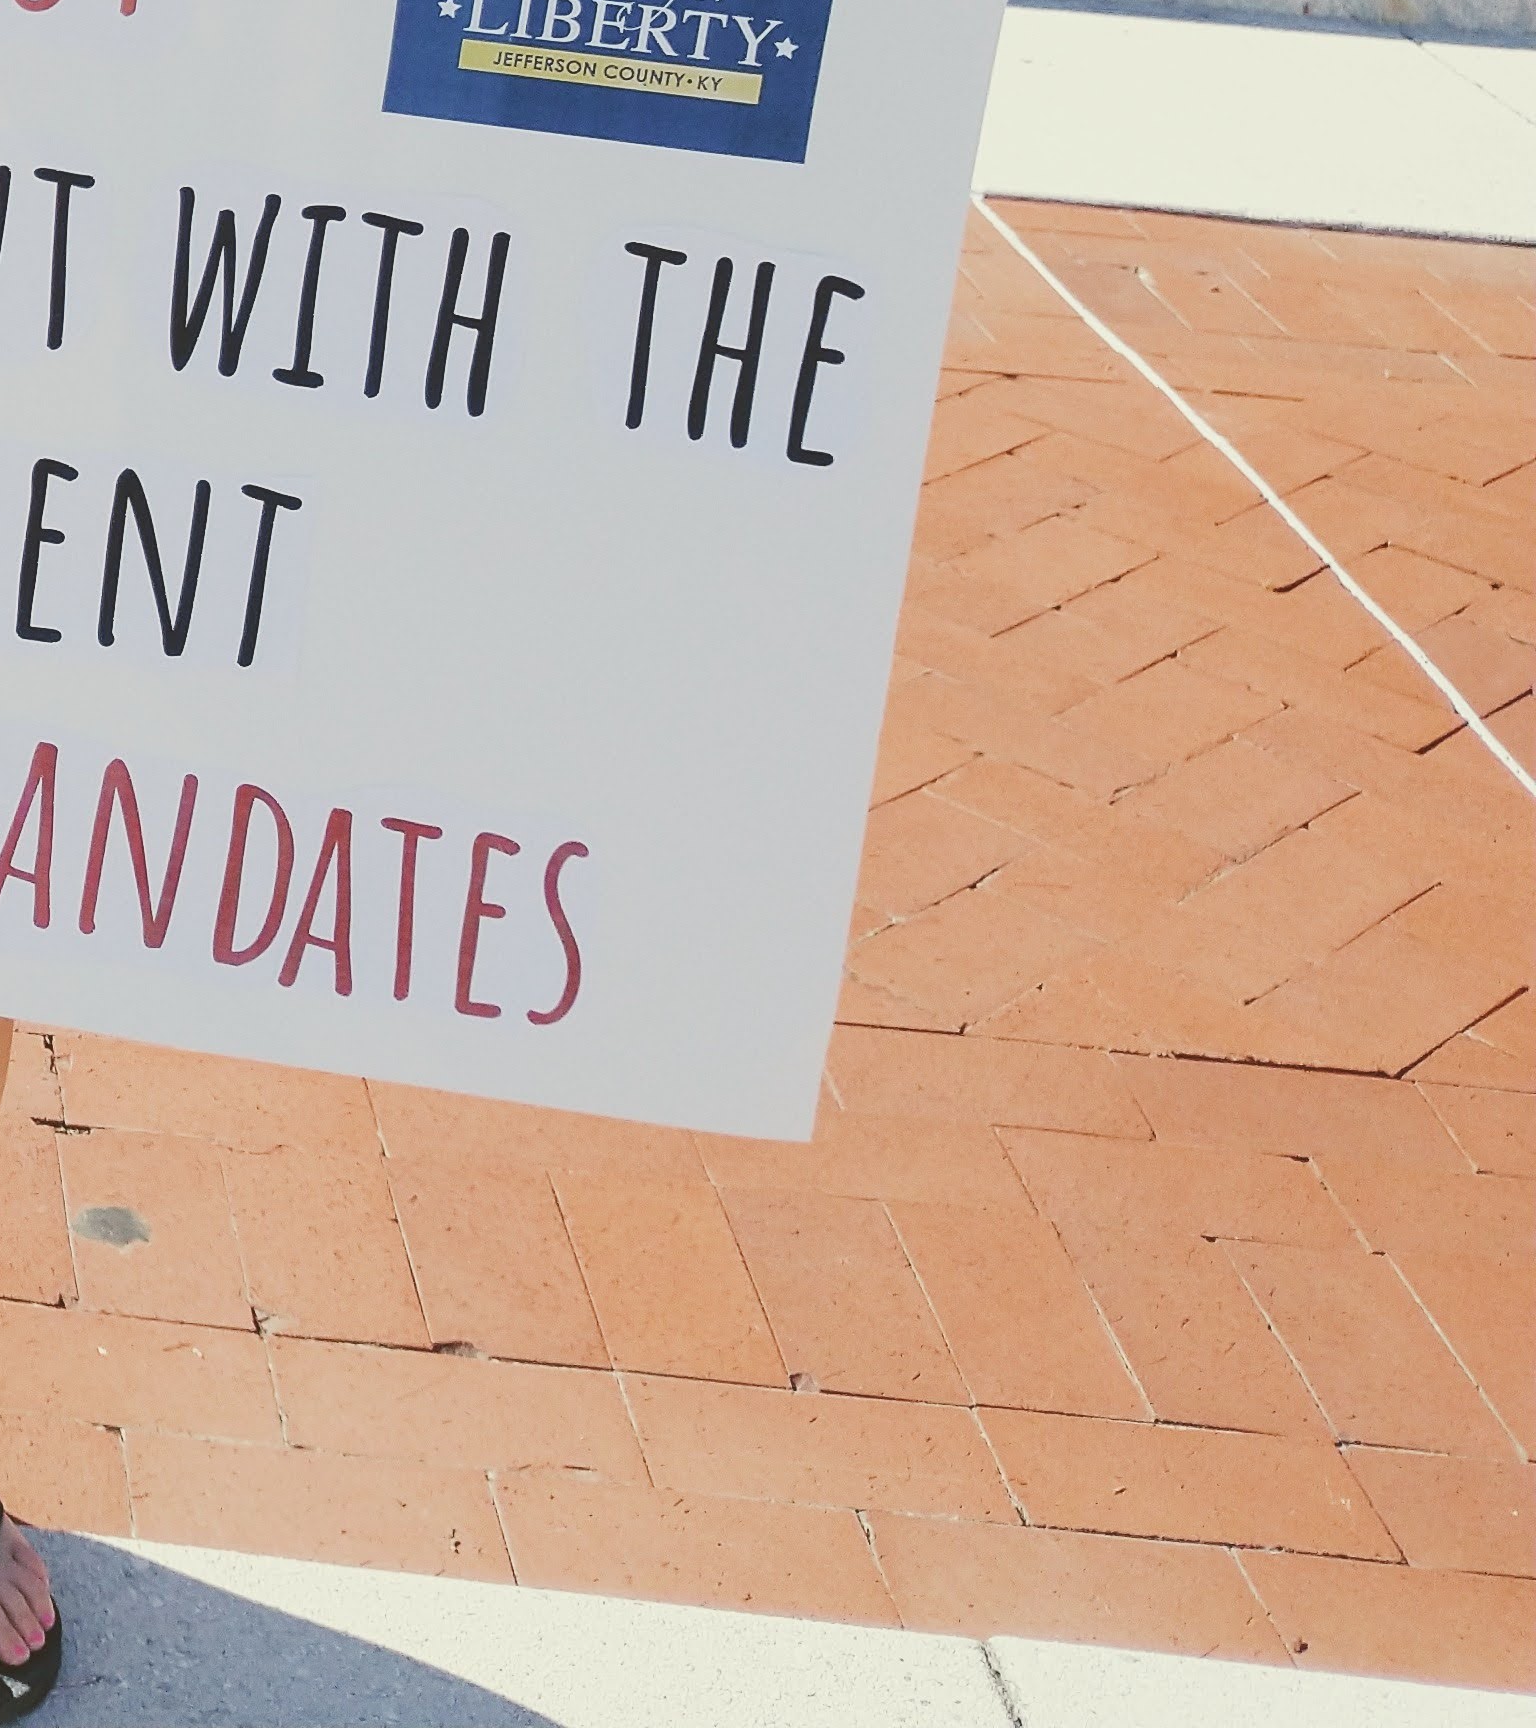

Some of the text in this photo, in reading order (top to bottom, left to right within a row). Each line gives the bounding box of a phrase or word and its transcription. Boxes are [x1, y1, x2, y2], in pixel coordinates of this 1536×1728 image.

[493, 51, 597, 77] JEFFERSON
[170, 186, 511, 417] WITH
[625, 241, 865, 467] THE
